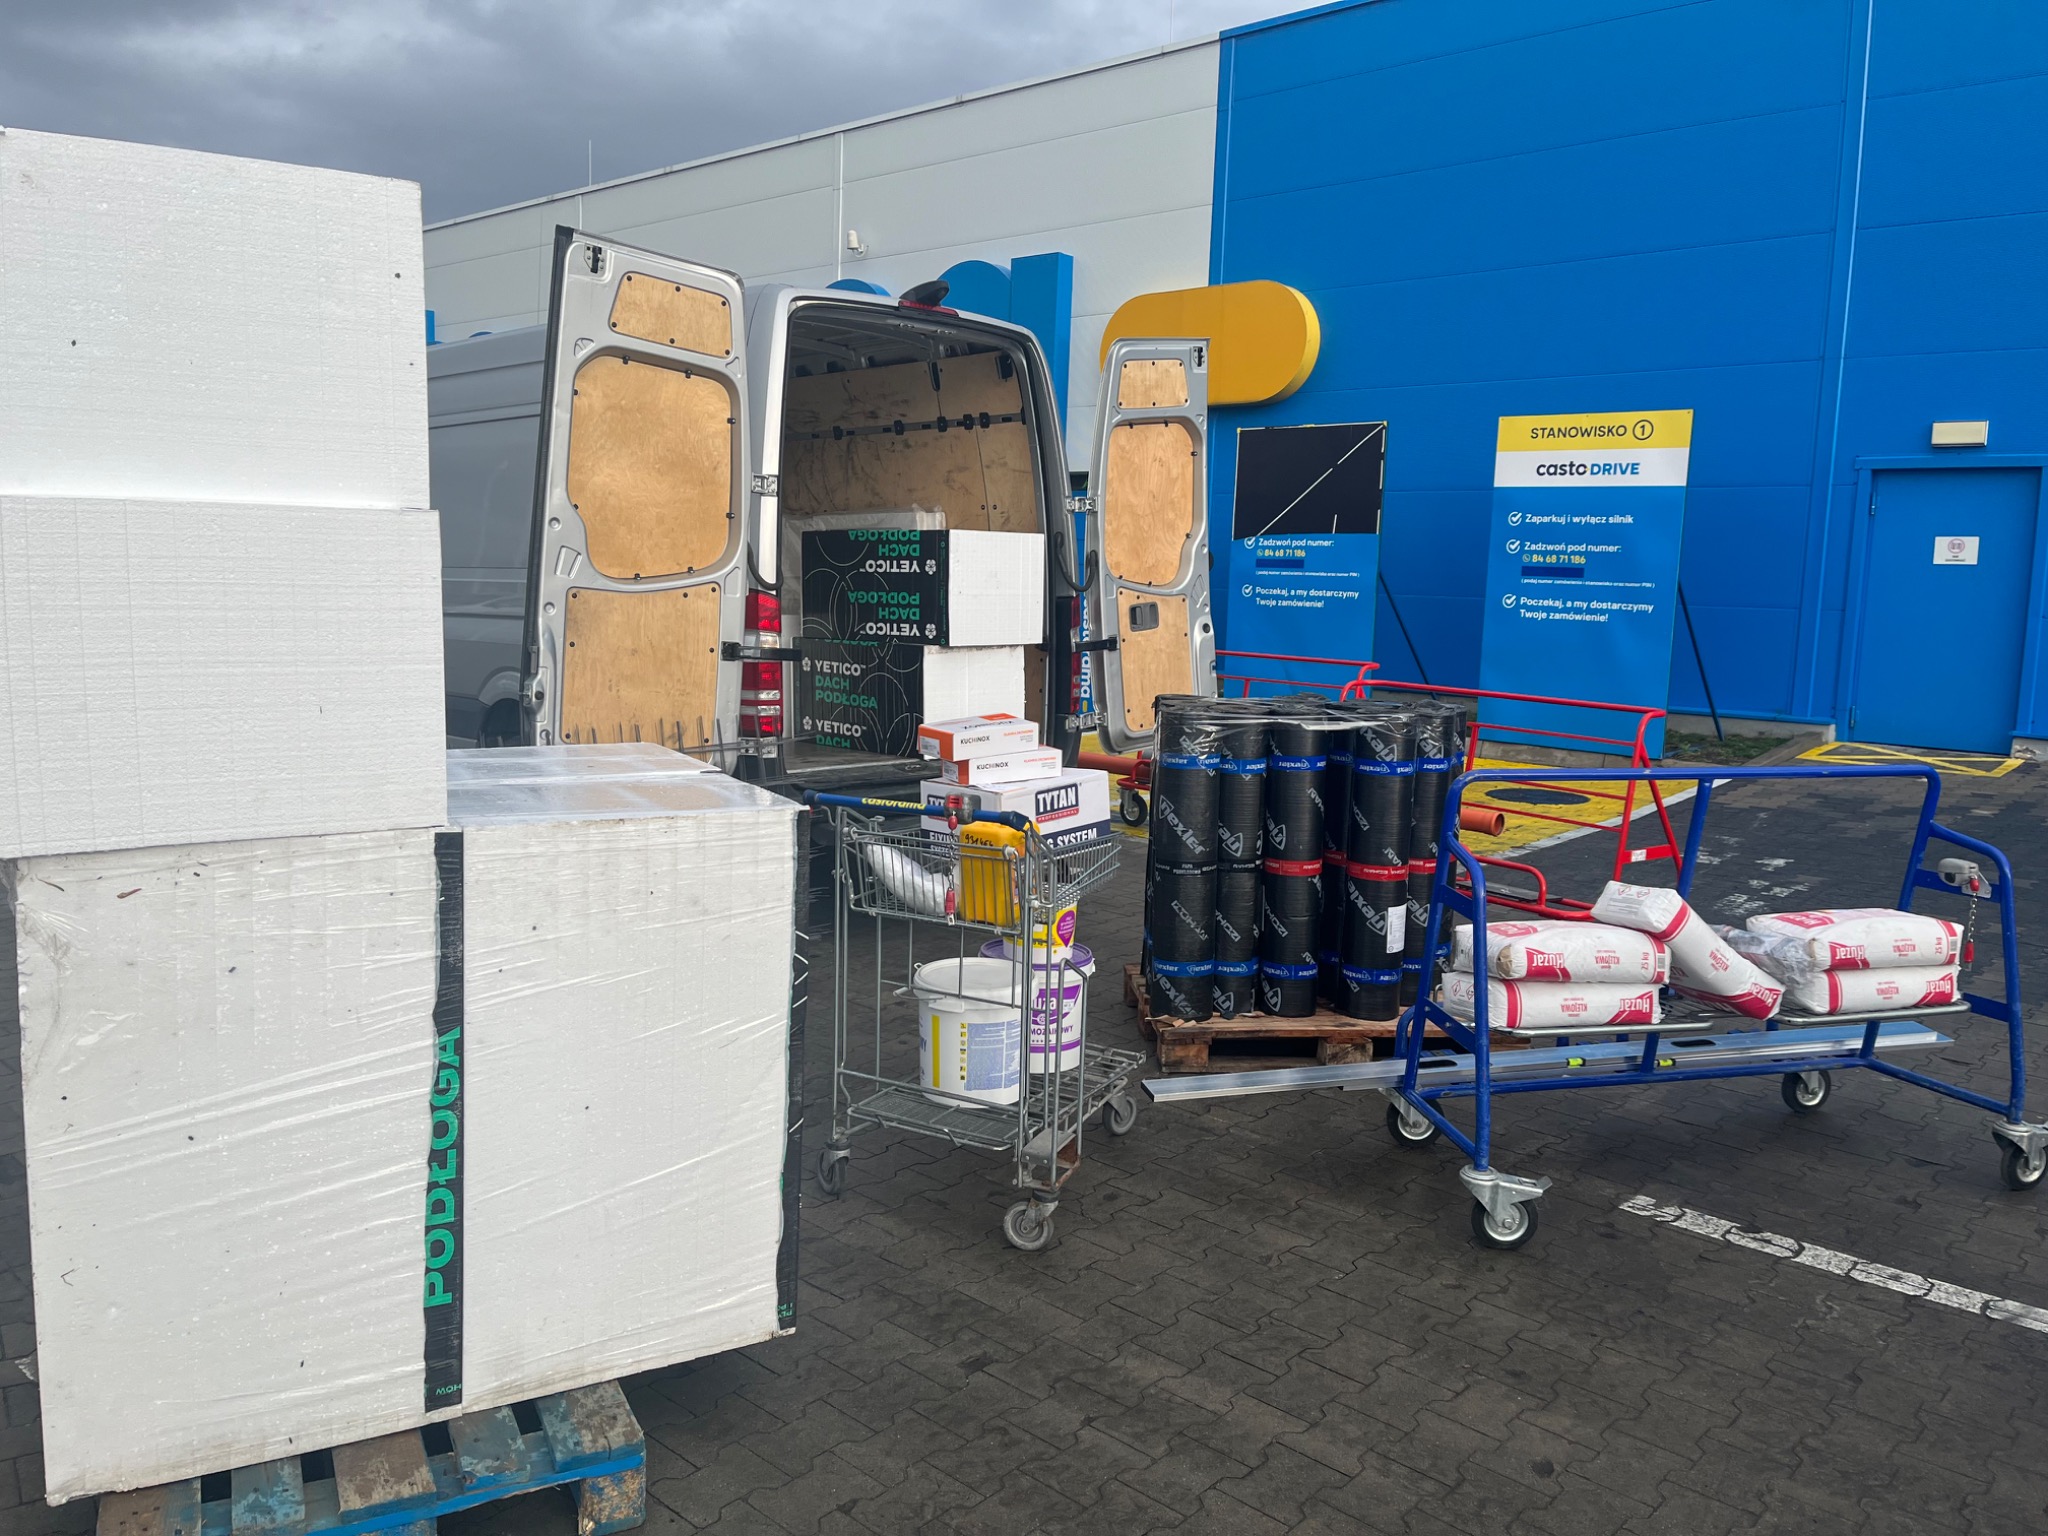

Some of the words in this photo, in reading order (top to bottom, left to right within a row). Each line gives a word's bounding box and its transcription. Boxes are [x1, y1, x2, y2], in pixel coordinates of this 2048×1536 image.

[1530, 424, 1627, 440] STANOWISKO
[1536, 460, 1588, 477] casto
[1590, 462, 1641, 476] DRIVE
[1525, 514, 1567, 525] Zaparkuj
[1572, 514, 1607, 525] wyłącz
[1608, 514, 1634, 524] silnik
[848, 530, 920, 541] PODŁOGA
[1258, 538, 1291, 547] Zadzwoń
[1292, 538, 1306, 548] pod
[1524, 542, 1566, 551] Zadzwoń
[1567, 543, 1586, 553] pod
[1587, 544, 1621, 553] numer:
[879, 544, 920, 557] DACH
[1532, 554, 1544, 563] 84
[1545, 554, 1557, 563] 68
[1559, 554, 1568, 563] 71
[1570, 555, 1586, 564] 186
[865, 560, 921, 573] YETICO
[848, 591, 920, 605] PODŁOGA
[1309, 589, 1359, 600] dostarczymy
[1256, 597, 1277, 608] Twoje
[1520, 596, 1564, 609] Poczekaj,
[1573, 601, 1588, 610] my
[1590, 599, 1654, 613] dostarczymy
[879, 607, 920, 621] DACH
[1519, 609, 1547, 621] Twoje
[1548, 611, 1608, 622] zamówienie!
[865, 622, 921, 637] YETICO
[815, 659, 861, 677] YETICO
[815, 675, 850, 690] DACH
[815, 690, 878, 709] PODŁOGA
[815, 719, 862, 737] YETICO
[816, 735, 851, 748] DACH
[977, 761, 1009, 771] KUCHINOX
[1037, 786, 1077, 813] TYTAN
[1835, 945, 1865, 960] Huzar
[1532, 952, 1565, 968] Huzar
[1640, 960, 1649, 971] 25
[1925, 980, 1951, 994] Huzar
[1750, 983, 1781, 1008] Huzar
[1560, 1003, 1588, 1013] KLEJOWA
[1619, 998, 1650, 1013] Huzar
[423, 1026, 461, 1309] PODŁOGA
